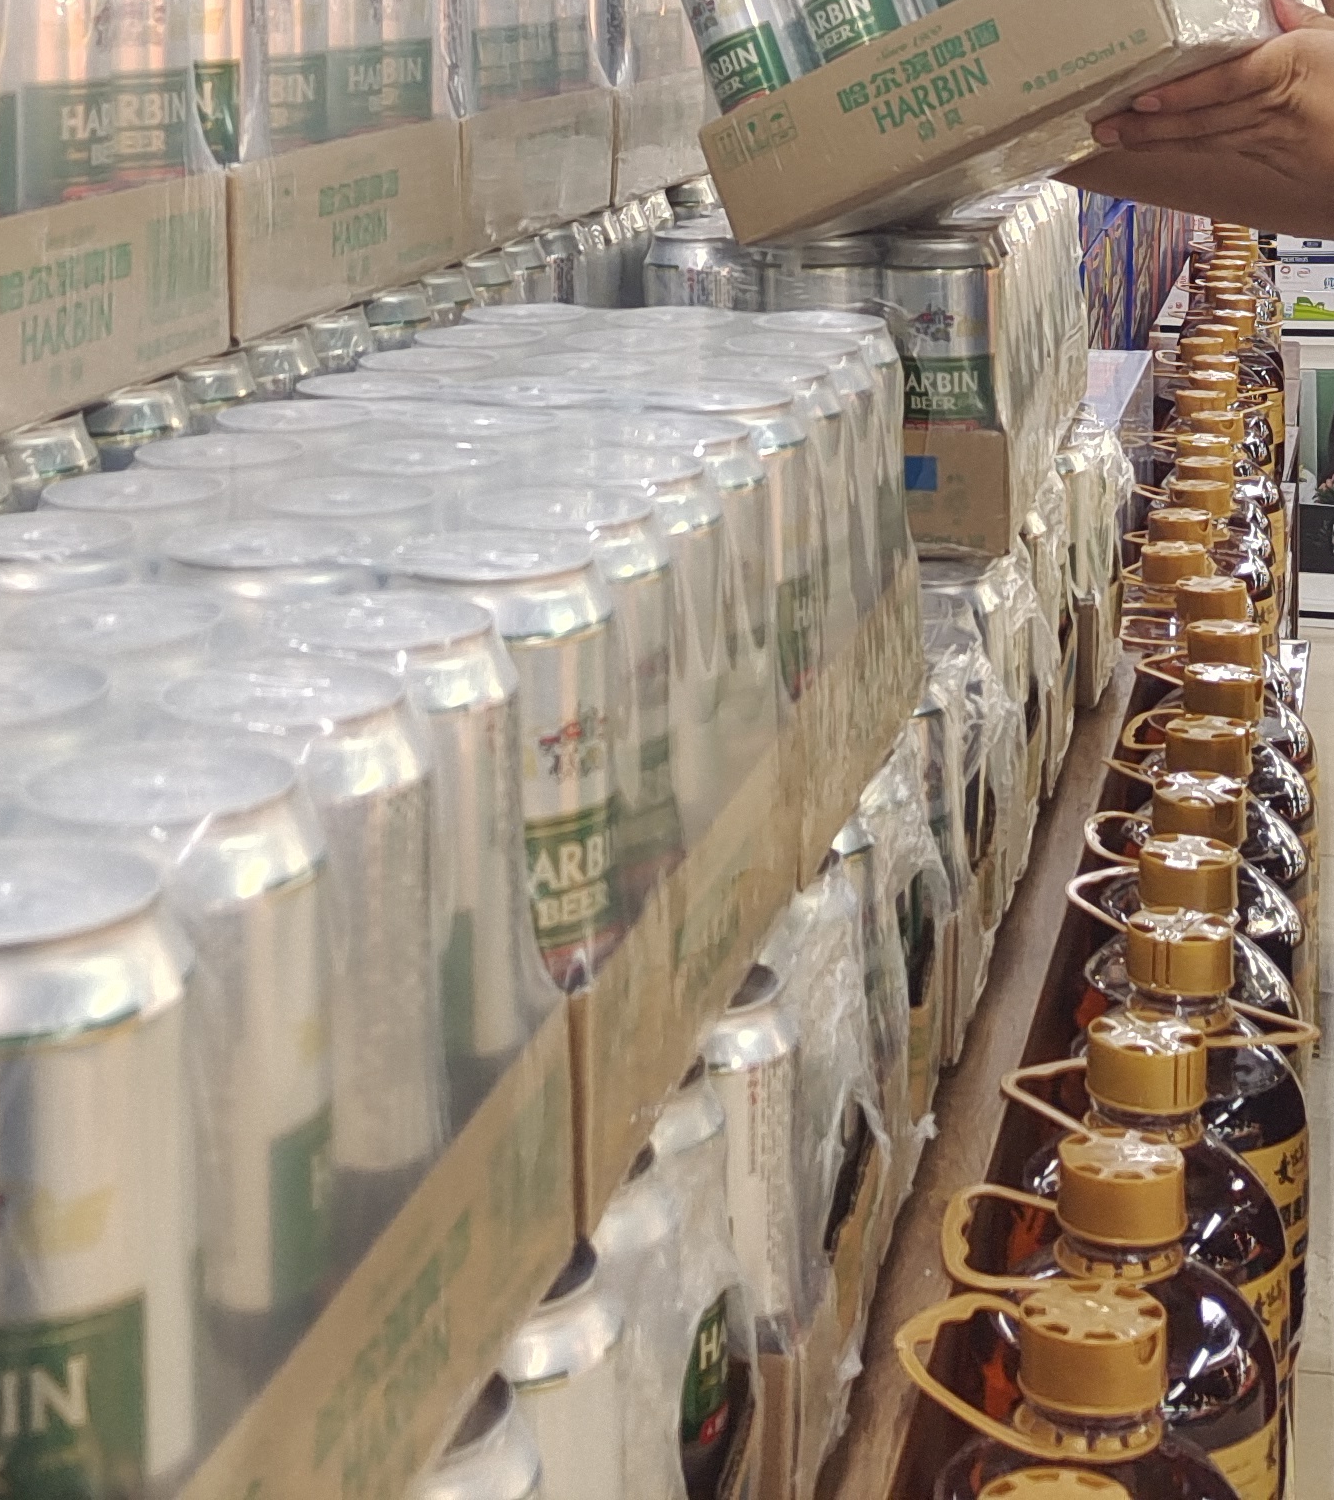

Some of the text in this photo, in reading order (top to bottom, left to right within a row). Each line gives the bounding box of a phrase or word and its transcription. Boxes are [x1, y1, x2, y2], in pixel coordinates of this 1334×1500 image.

[837, 18, 1001, 114] 哈尔滨啤酒
[872, 57, 990, 135] HARBIN
